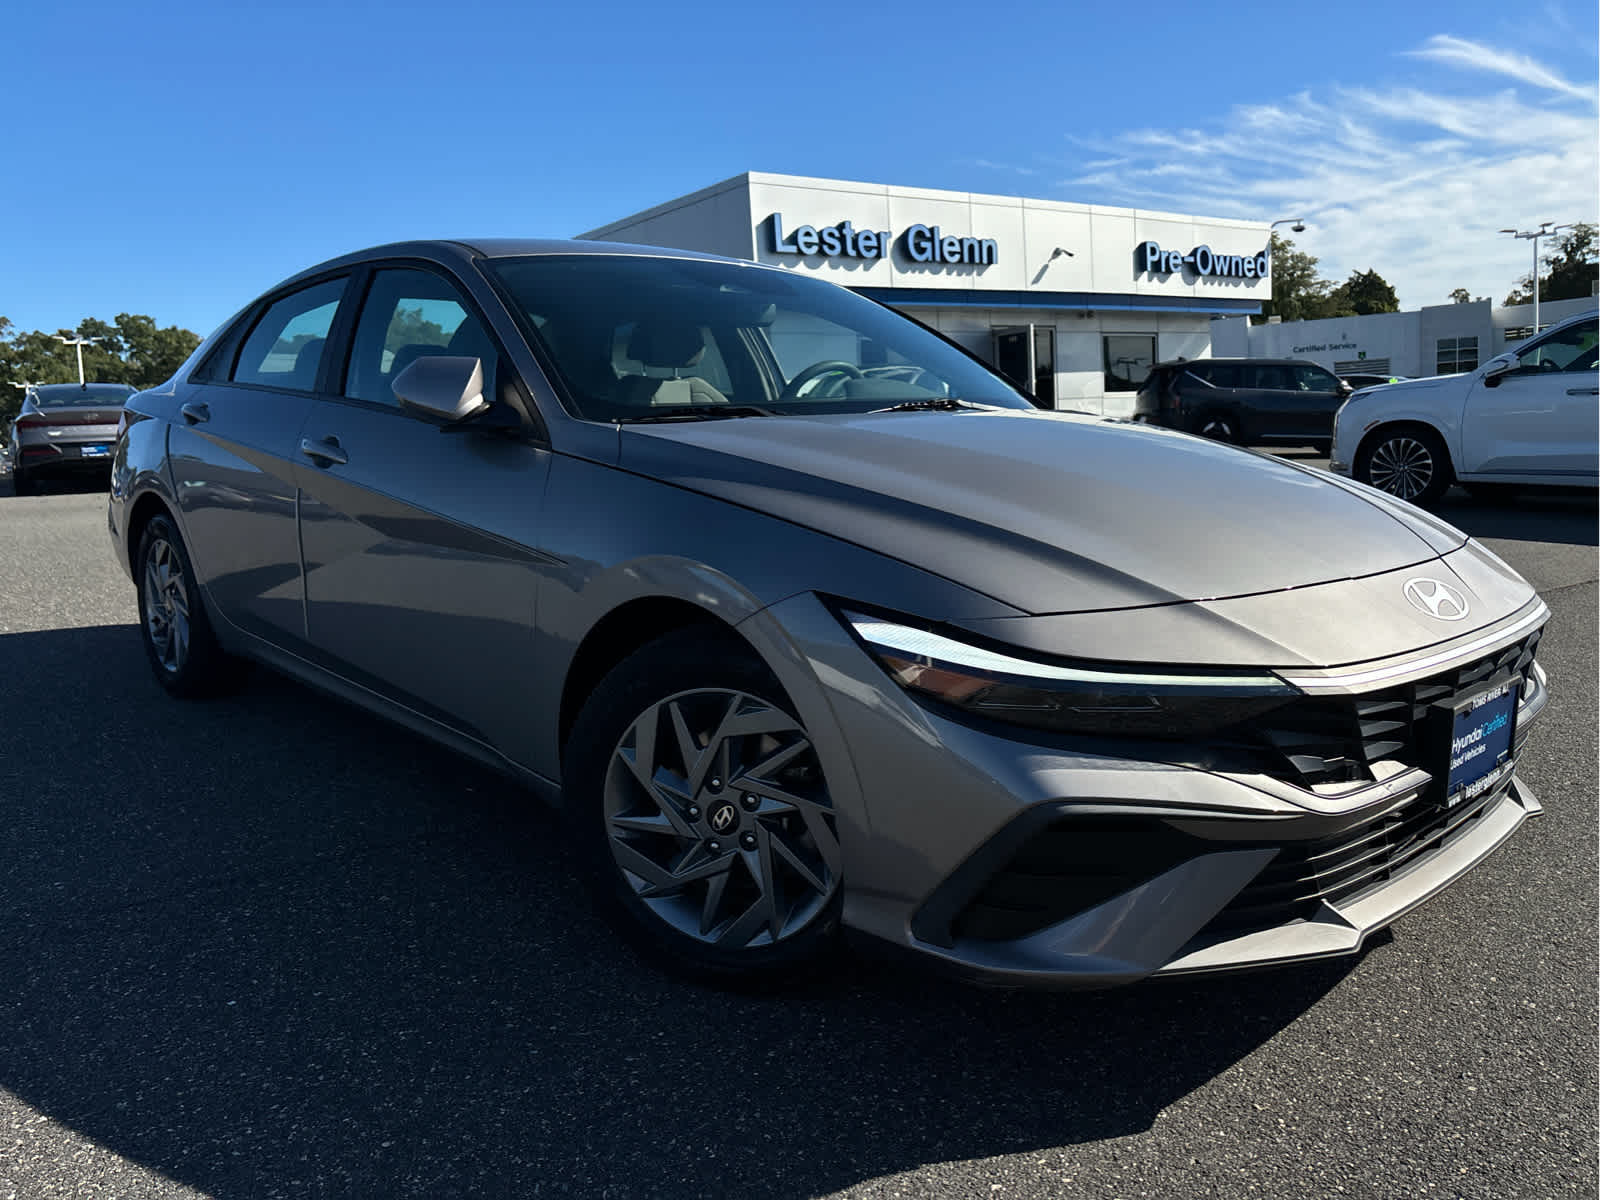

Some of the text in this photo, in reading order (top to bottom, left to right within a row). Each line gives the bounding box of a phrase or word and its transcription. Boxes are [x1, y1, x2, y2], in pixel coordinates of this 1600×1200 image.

[773, 212, 998, 264] Lester Glenn
[1146, 241, 1269, 278] Pre-Owned
[1292, 343, 1358, 354] Certified Service
[1464, 743, 1487, 762] Vehicles
